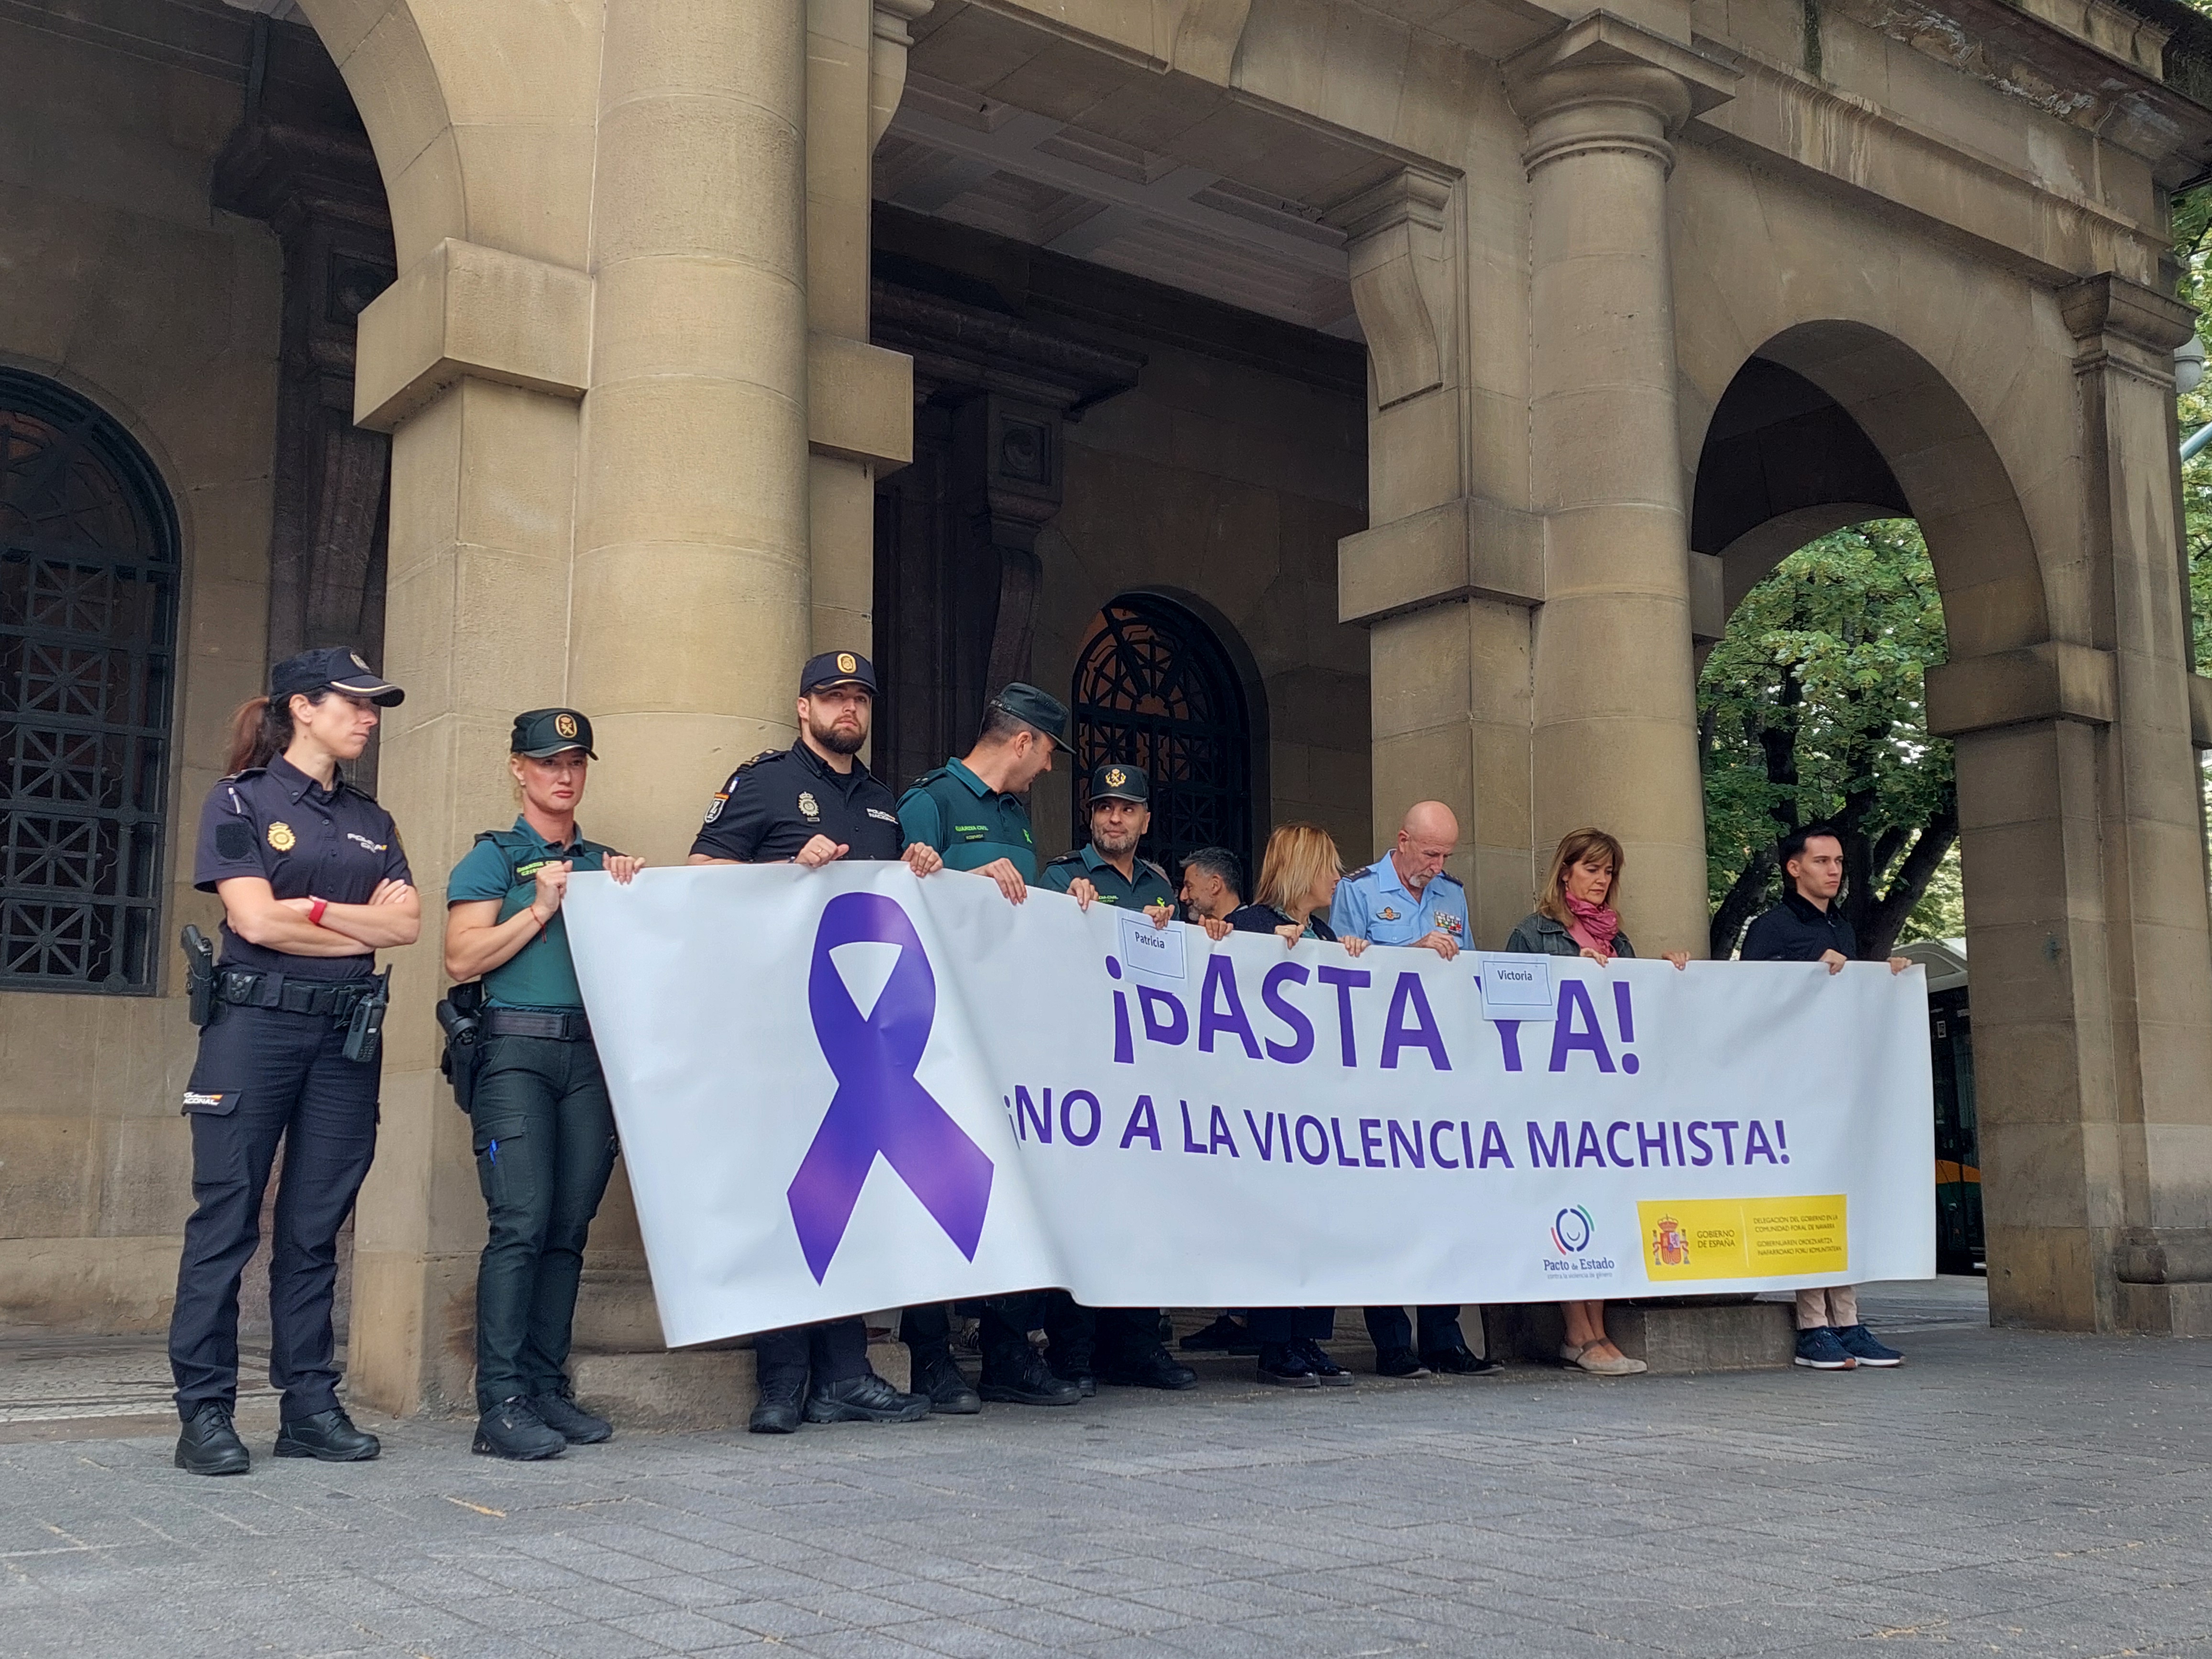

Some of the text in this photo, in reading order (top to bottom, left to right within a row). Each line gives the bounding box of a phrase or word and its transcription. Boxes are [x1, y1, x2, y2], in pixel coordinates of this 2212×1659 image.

[1135, 931, 1165, 949] Patricia
[1497, 970, 1532, 981] Victoria
[1004, 1085, 1790, 1169] ¡NO A LA VIOLENCIA MACHISTA!
[1697, 1229, 1735, 1238] GOBIERNO
[1698, 1238, 1736, 1248] DE ESPAÑA
[1543, 1259, 1569, 1271] Pacto
[1579, 1257, 1615, 1270] Estado
